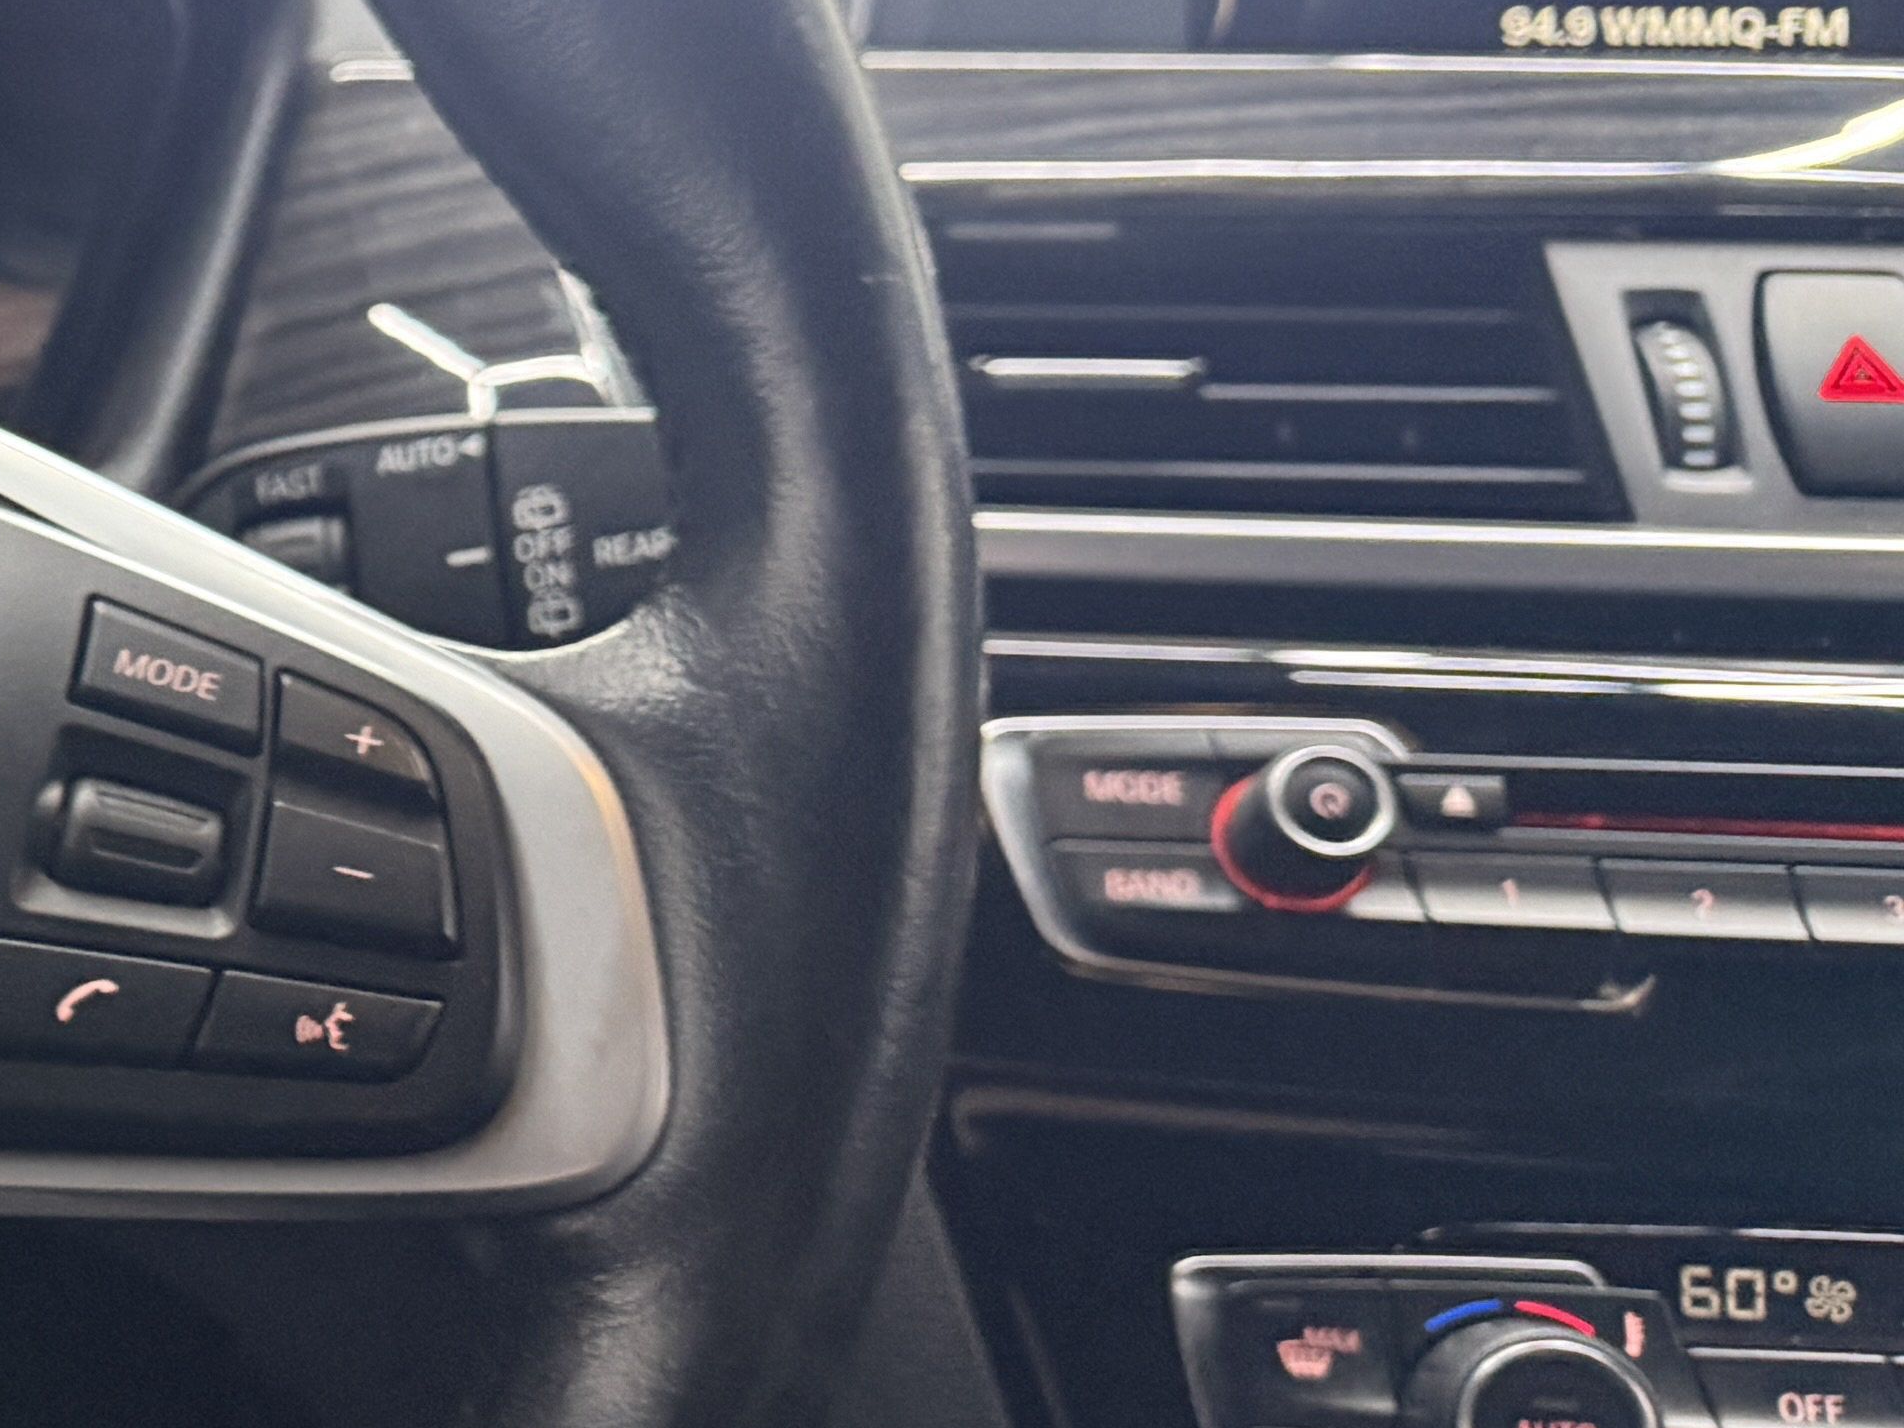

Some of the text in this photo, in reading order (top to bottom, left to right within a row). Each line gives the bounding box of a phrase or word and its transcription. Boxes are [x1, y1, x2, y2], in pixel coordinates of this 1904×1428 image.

[1499, 5, 1849, 50] 94.9 WMMQ-FM
[376, 437, 458, 475] AUTO
[254, 465, 323, 504] FAST
[113, 648, 224, 703] MODE
[1083, 770, 1184, 806] MODE
[1105, 867, 1201, 903] BAND
[1501, 877, 1520, 910] 1
[1691, 887, 1716, 920] 2
[1778, 1391, 1847, 1425] OFF
